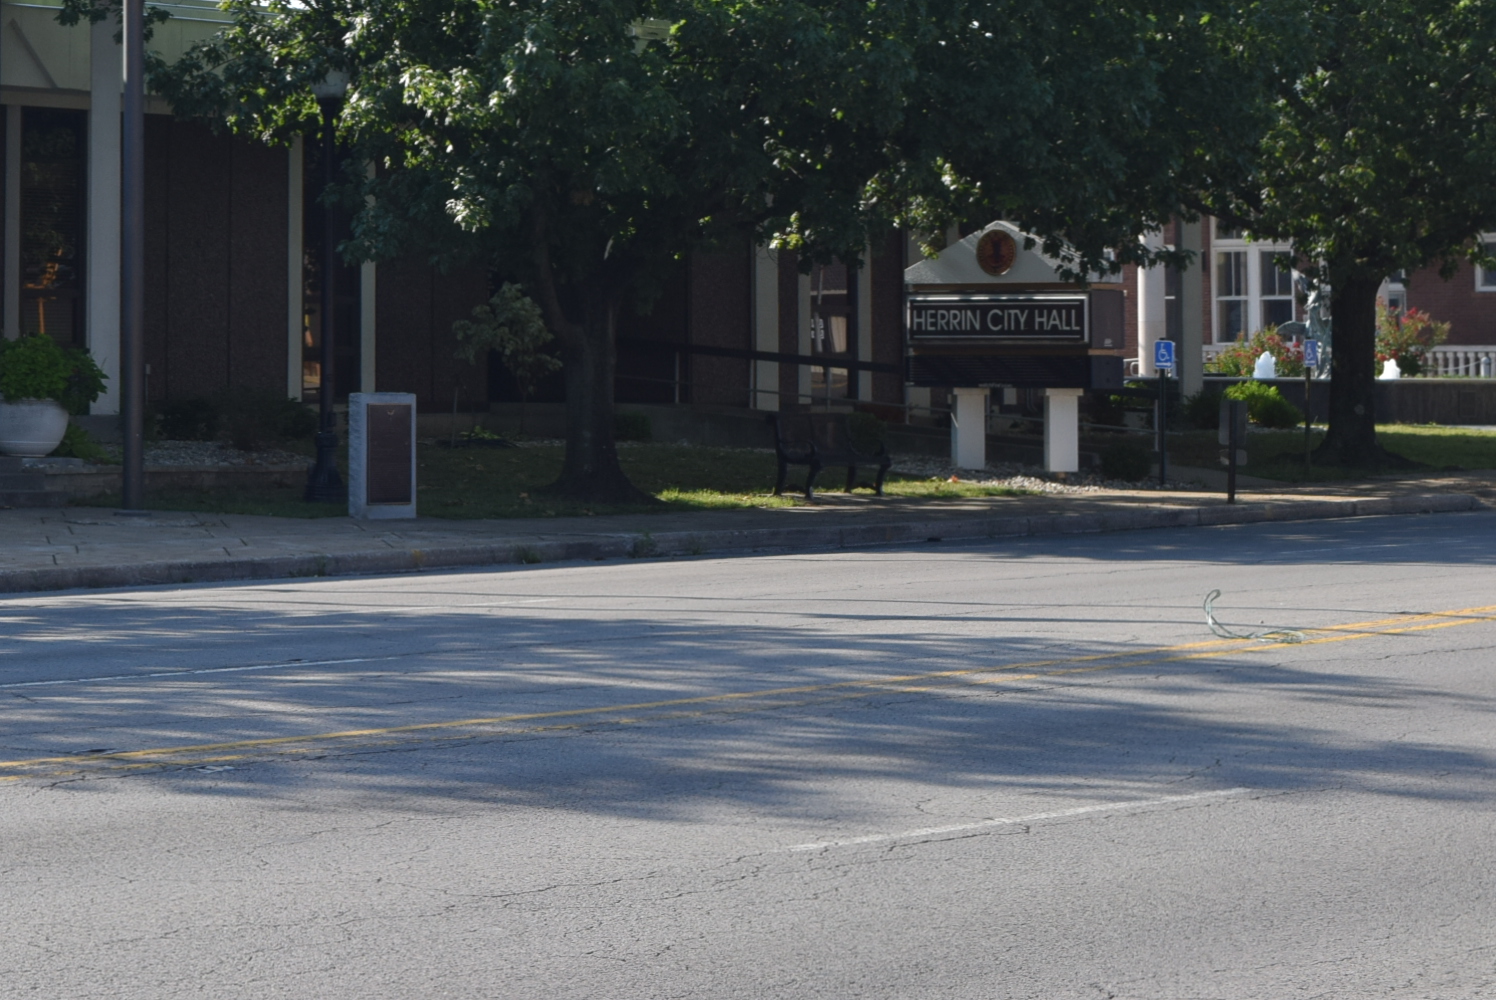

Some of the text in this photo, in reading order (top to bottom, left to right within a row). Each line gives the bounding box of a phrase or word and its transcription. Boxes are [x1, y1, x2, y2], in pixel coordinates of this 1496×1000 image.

[913, 308, 1081, 332] HERRIN CITY HALL
